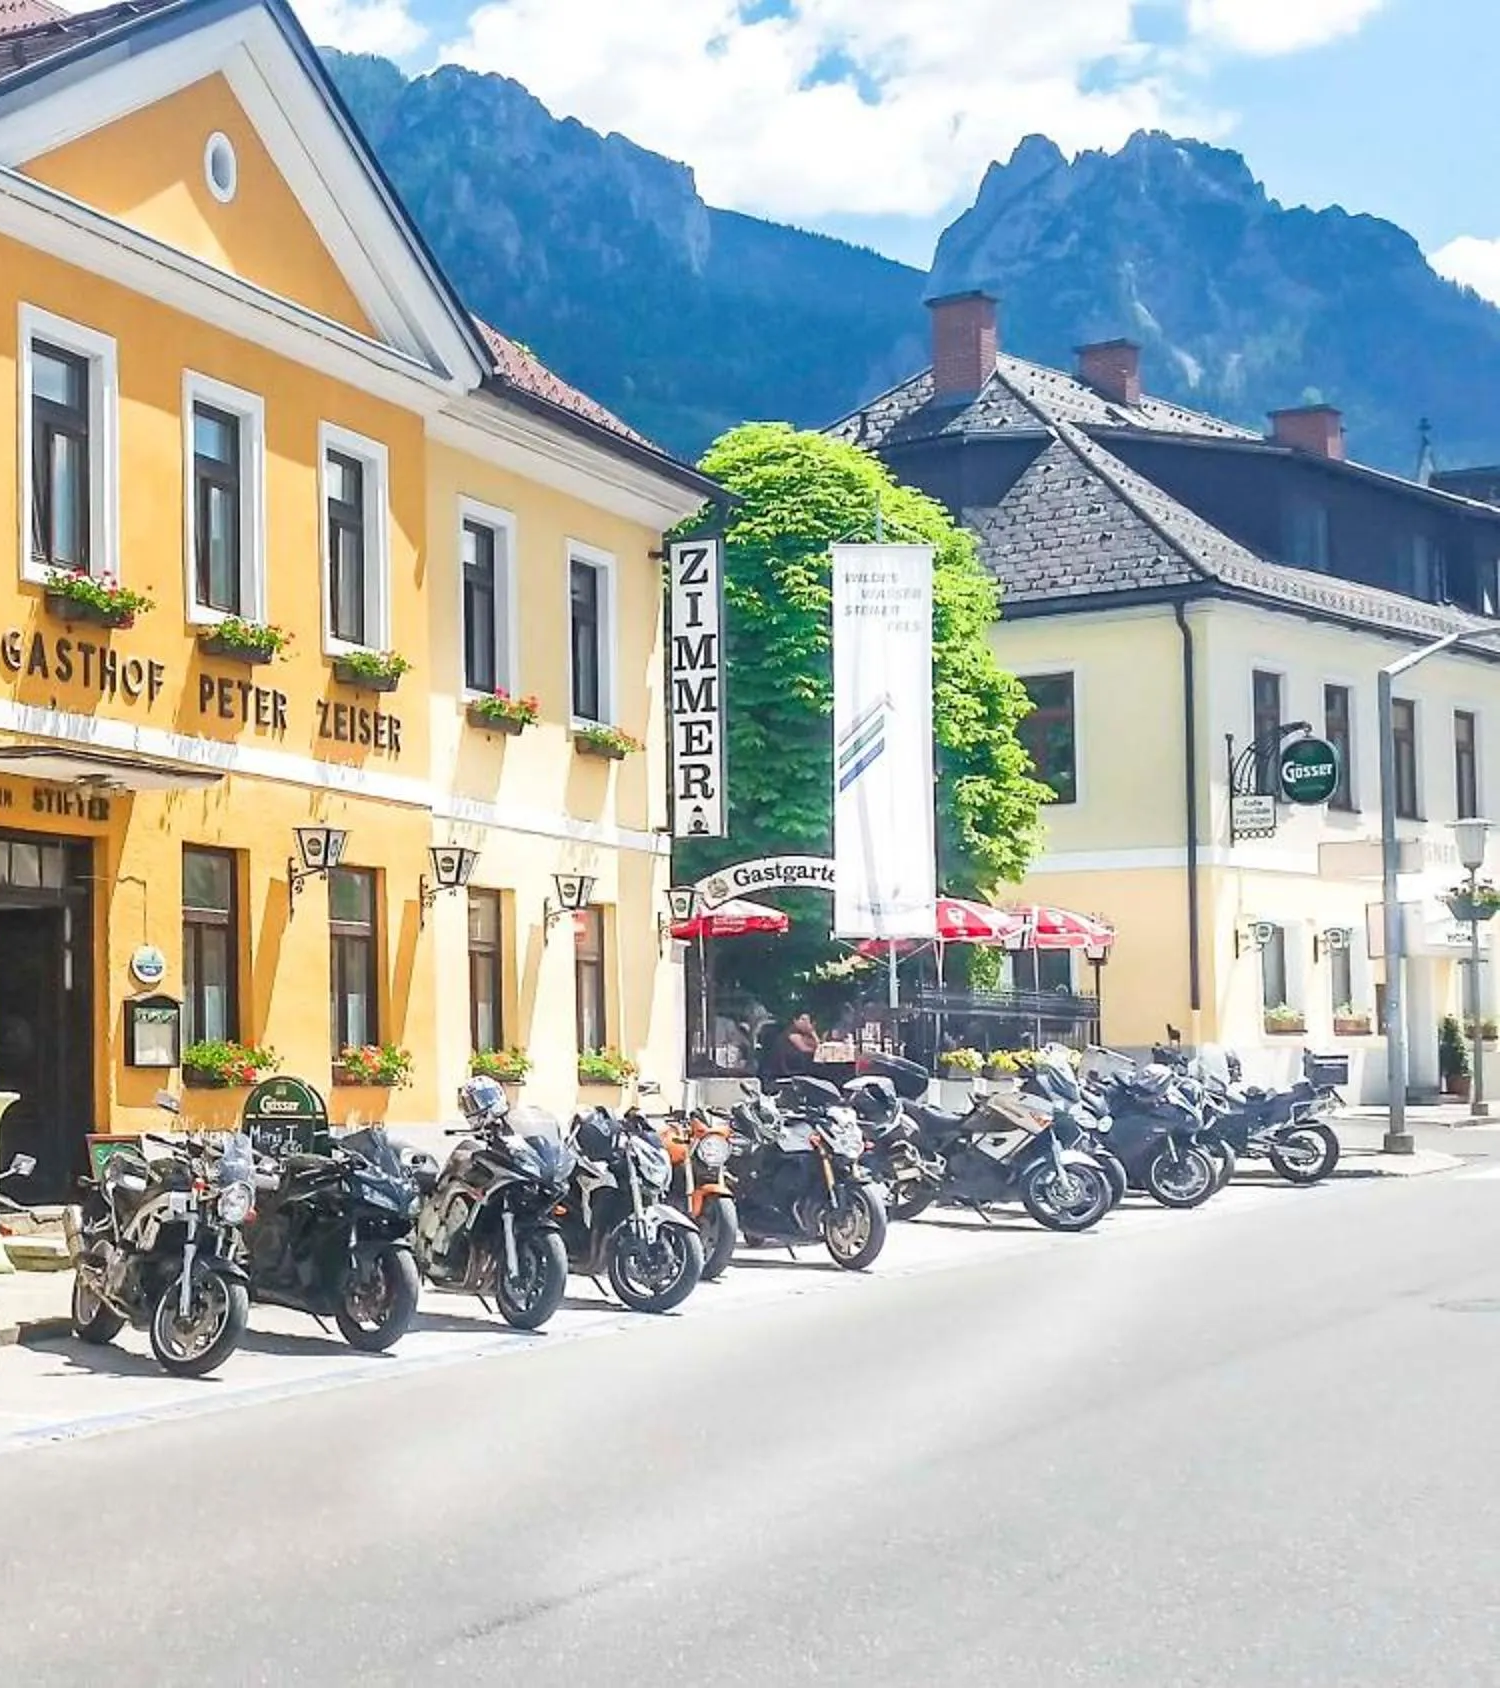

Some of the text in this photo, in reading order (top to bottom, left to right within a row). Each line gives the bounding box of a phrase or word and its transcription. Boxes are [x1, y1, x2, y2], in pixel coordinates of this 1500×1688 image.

[1, 631, 401, 753] GASTHOF PETER ZEISER
[673, 548, 717, 801] ZIMMER
[1281, 761, 1333, 783] Gösser
